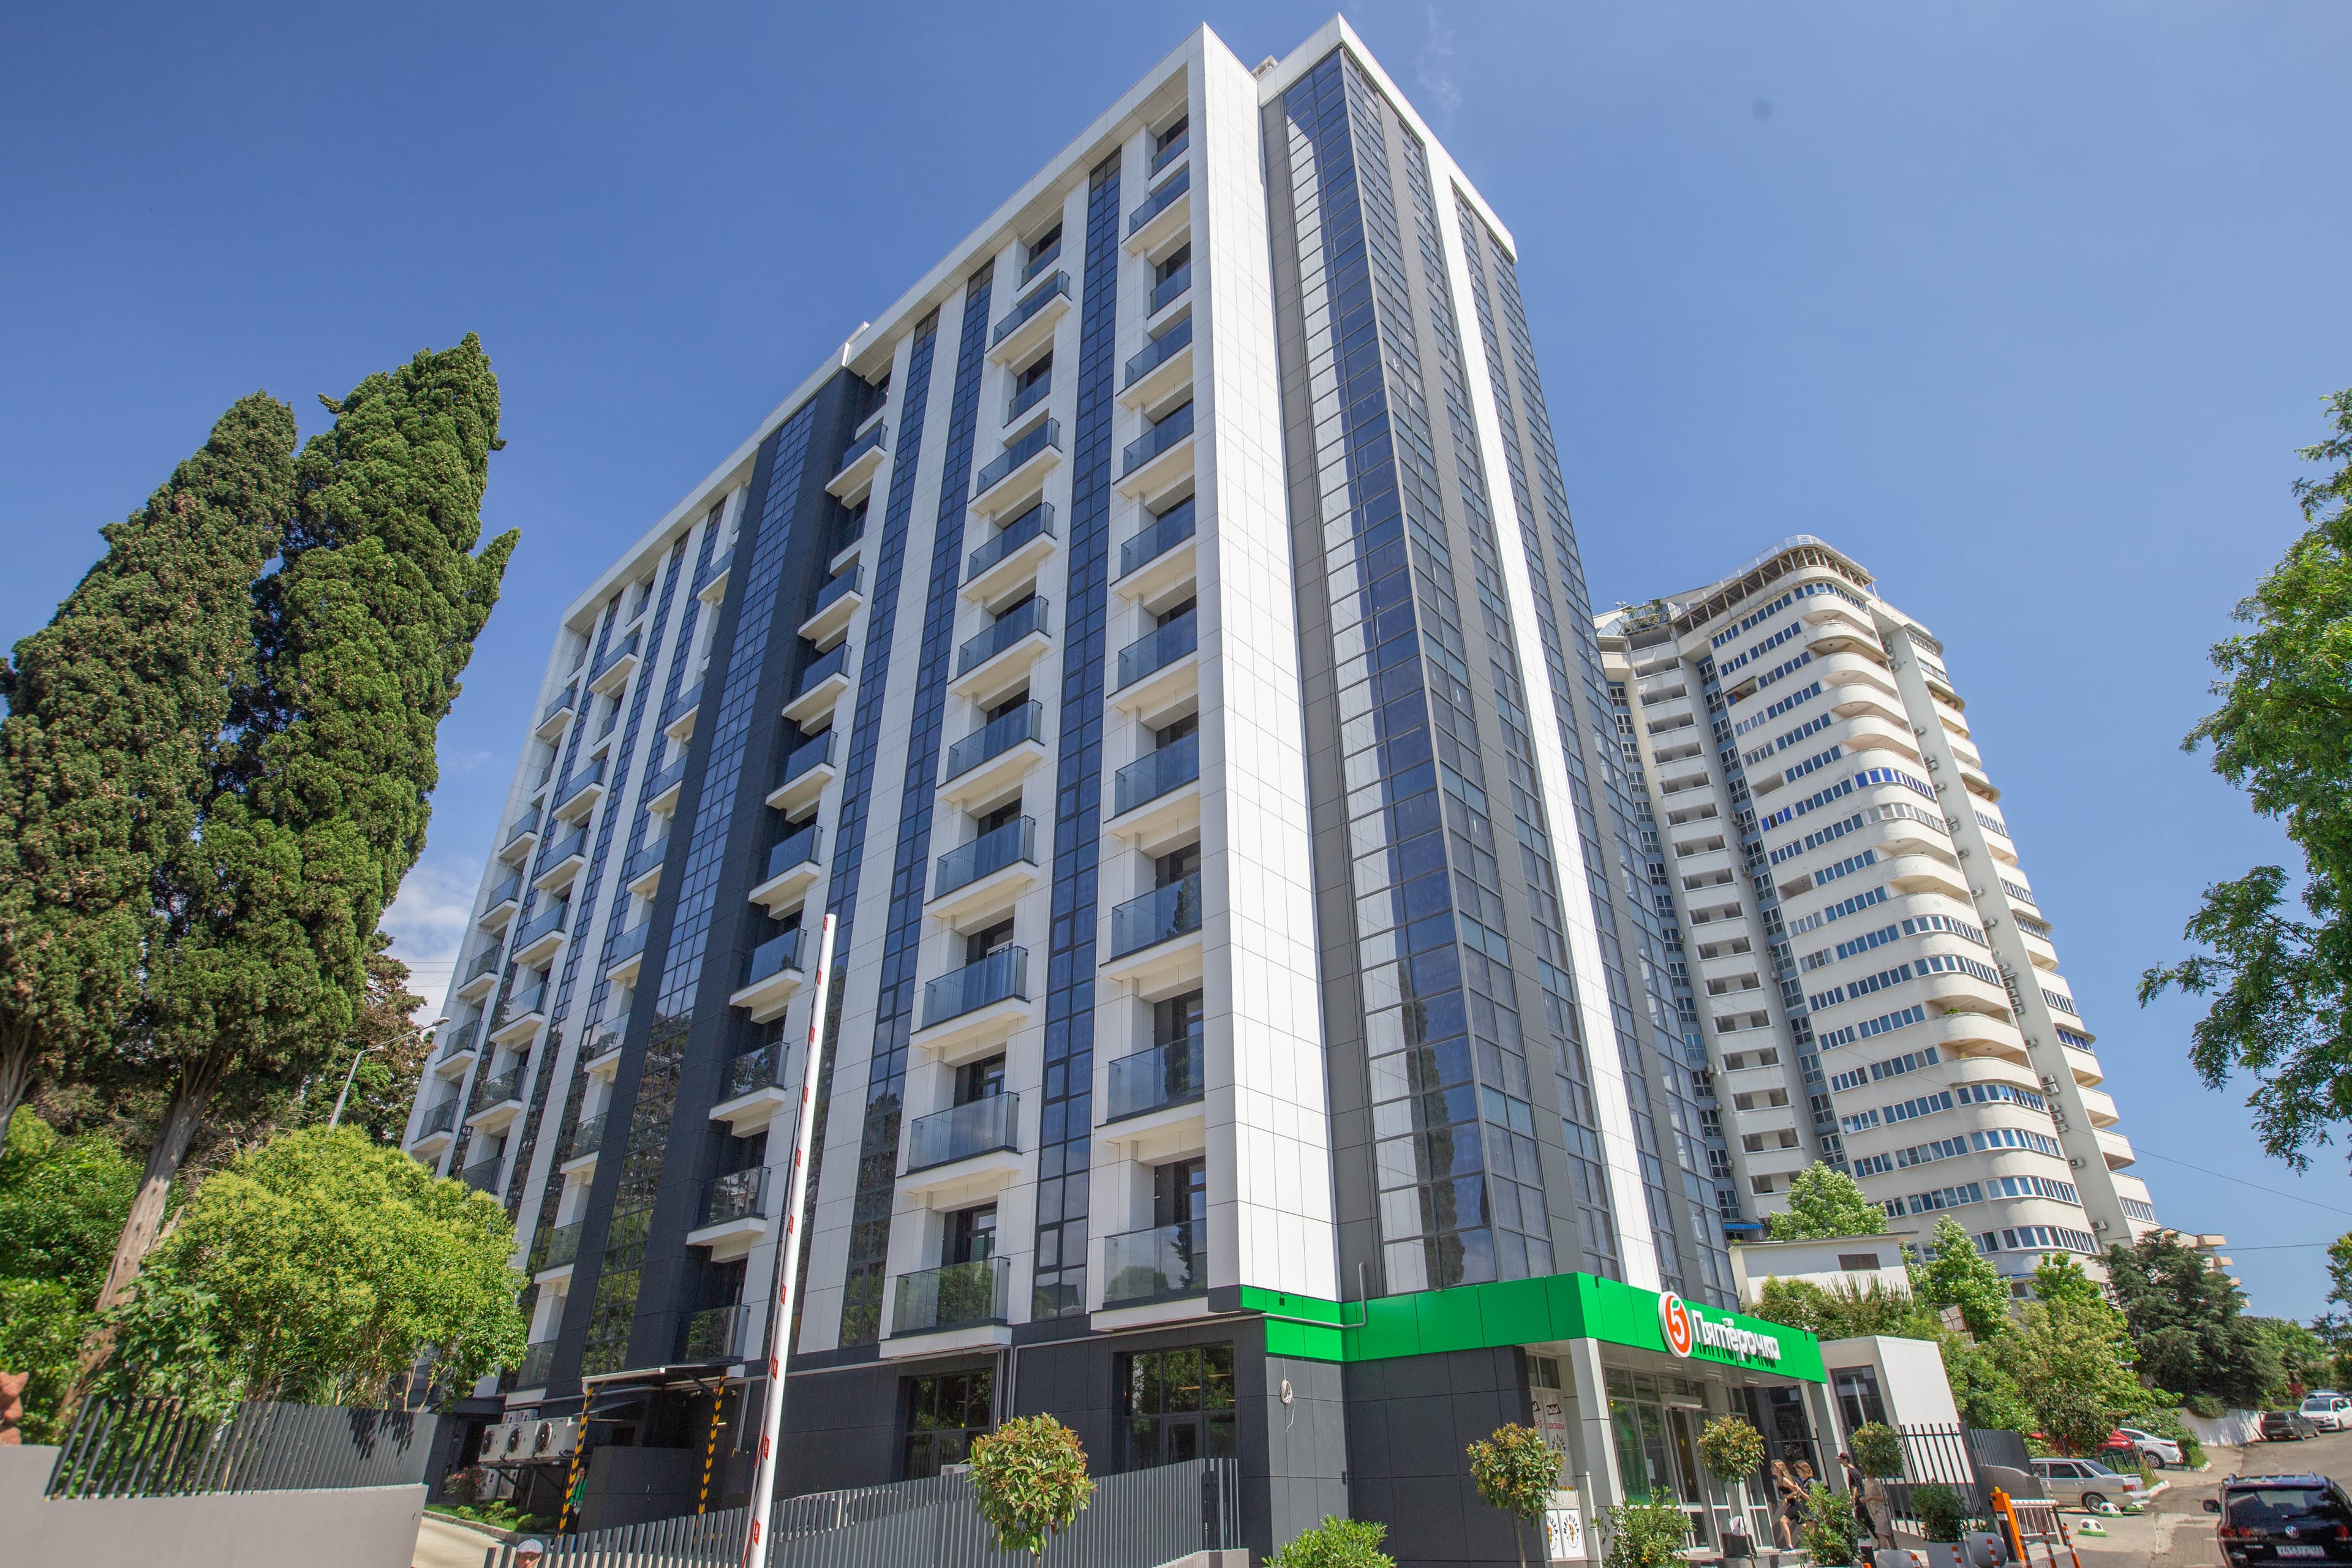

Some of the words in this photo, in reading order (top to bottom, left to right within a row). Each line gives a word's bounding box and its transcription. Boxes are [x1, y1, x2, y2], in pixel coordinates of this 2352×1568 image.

[1671, 1298, 1685, 1345] 5
[1692, 1310, 1781, 1361] Пятёрочка
[1569, 1514, 1579, 1533] PIZZA
